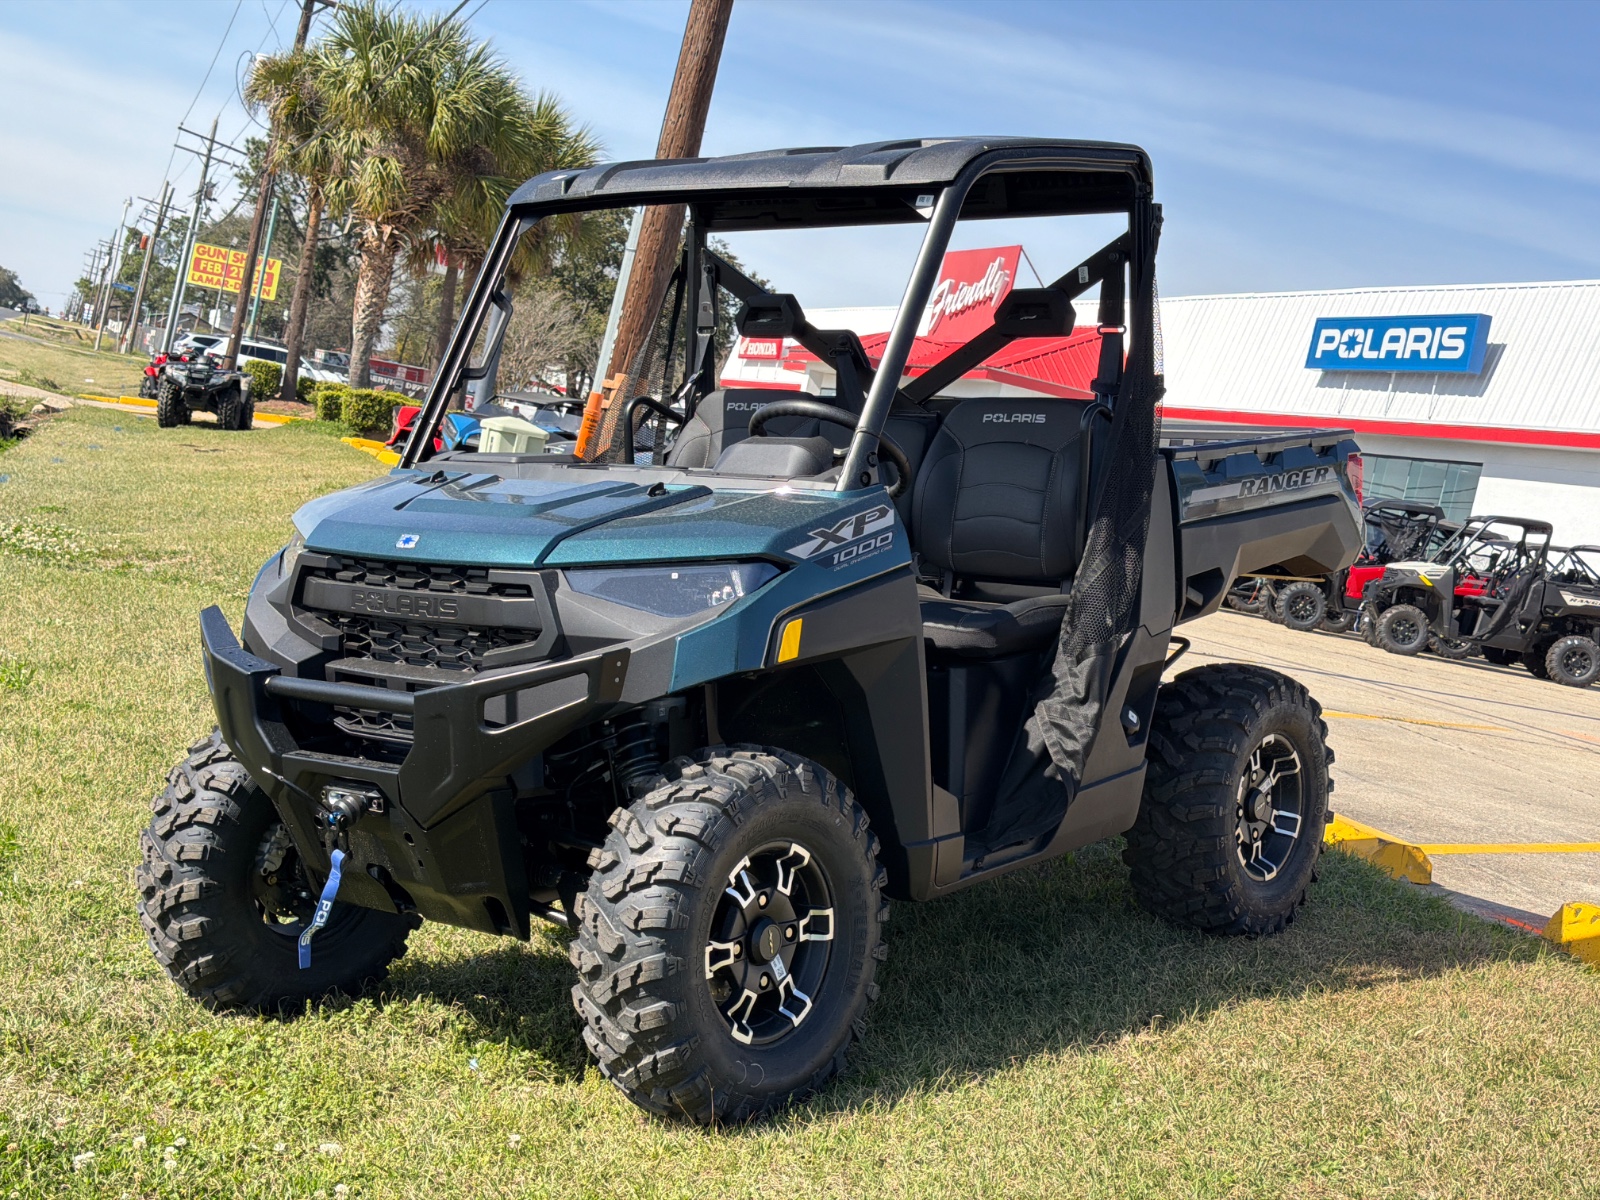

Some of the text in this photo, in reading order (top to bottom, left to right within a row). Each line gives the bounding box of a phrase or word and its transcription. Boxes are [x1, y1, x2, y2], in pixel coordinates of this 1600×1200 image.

[196, 245, 228, 261] GUN
[191, 273, 271, 297] LAMAR-DON
[229, 267, 268, 285] 212
[928, 256, 1009, 331] Friendly
[747, 342, 777, 356] HONDA
[1315, 327, 1467, 359] POLARIS
[726, 402, 769, 411] POLAR
[982, 413, 1047, 424] POLARIS
[1237, 465, 1330, 499] RANGER
[806, 504, 891, 558] XP
[833, 532, 893, 565] 1000
[351, 589, 460, 620] POLARIS
[1569, 598, 1600, 607] RANG
